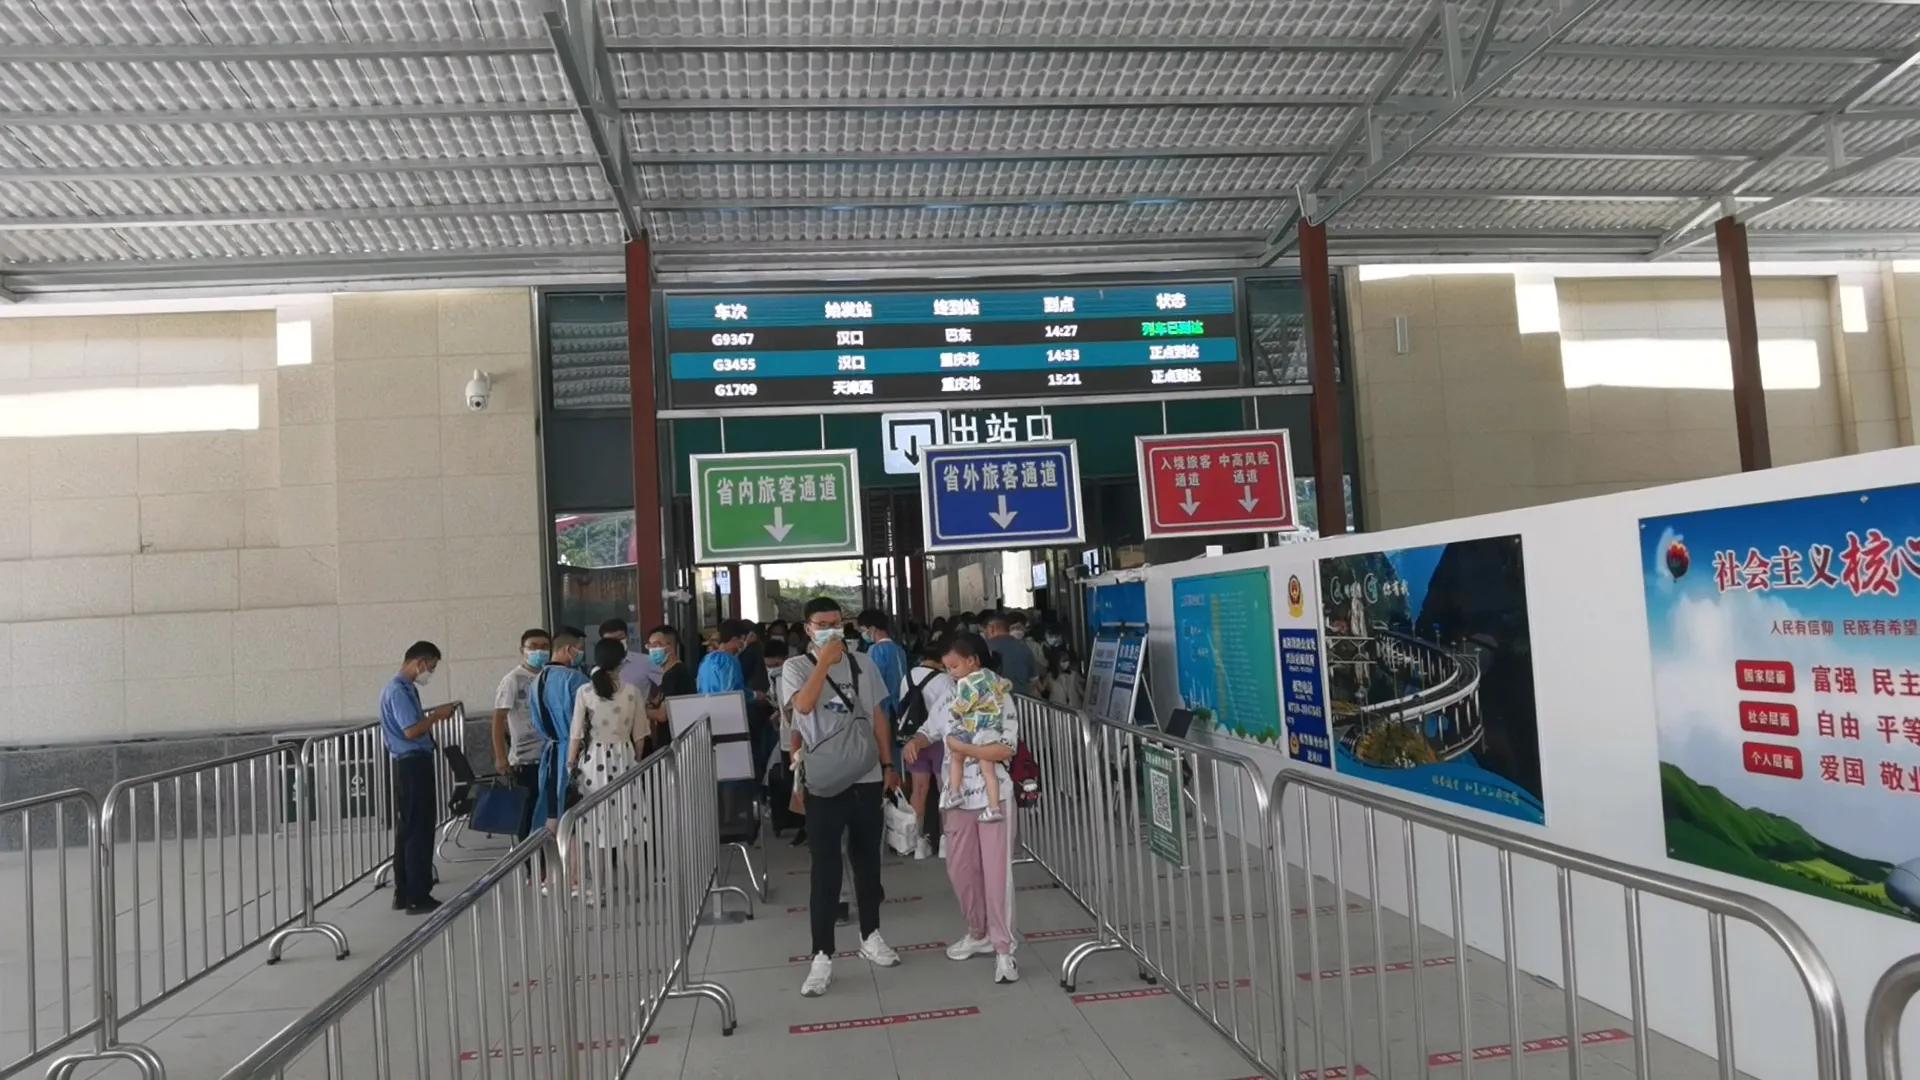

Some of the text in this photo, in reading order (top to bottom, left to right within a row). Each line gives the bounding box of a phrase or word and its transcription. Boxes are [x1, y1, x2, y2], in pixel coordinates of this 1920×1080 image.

[714, 292, 1186, 320] 车次 始发站 终到站 到点 状态
[711, 320, 1205, 346] G9367 汉口 巴东 14:27 列车已到达
[712, 344, 1200, 372] G3455 汉口 重庆北 14:53 正点到达
[714, 367, 1202, 397] G1709 天津西 重庆北 15:21 正点到达
[951, 411, 1053, 444] 出站口
[943, 460, 1058, 492] 省外旅客通道
[1160, 451, 1271, 471] 入境旅客 中高风险
[716, 474, 837, 506] 省内旅客通道
[1175, 469, 1259, 487] 通道 通道
[1770, 619, 1918, 637] 人民有信仰 民族有希望
[1743, 665, 1920, 697] 国家层面 富强 民主
[1748, 710, 1920, 746] 社会层面 自由 平等
[1752, 751, 1794, 770] 个人层面
[1819, 754, 1865, 785] 爱国
